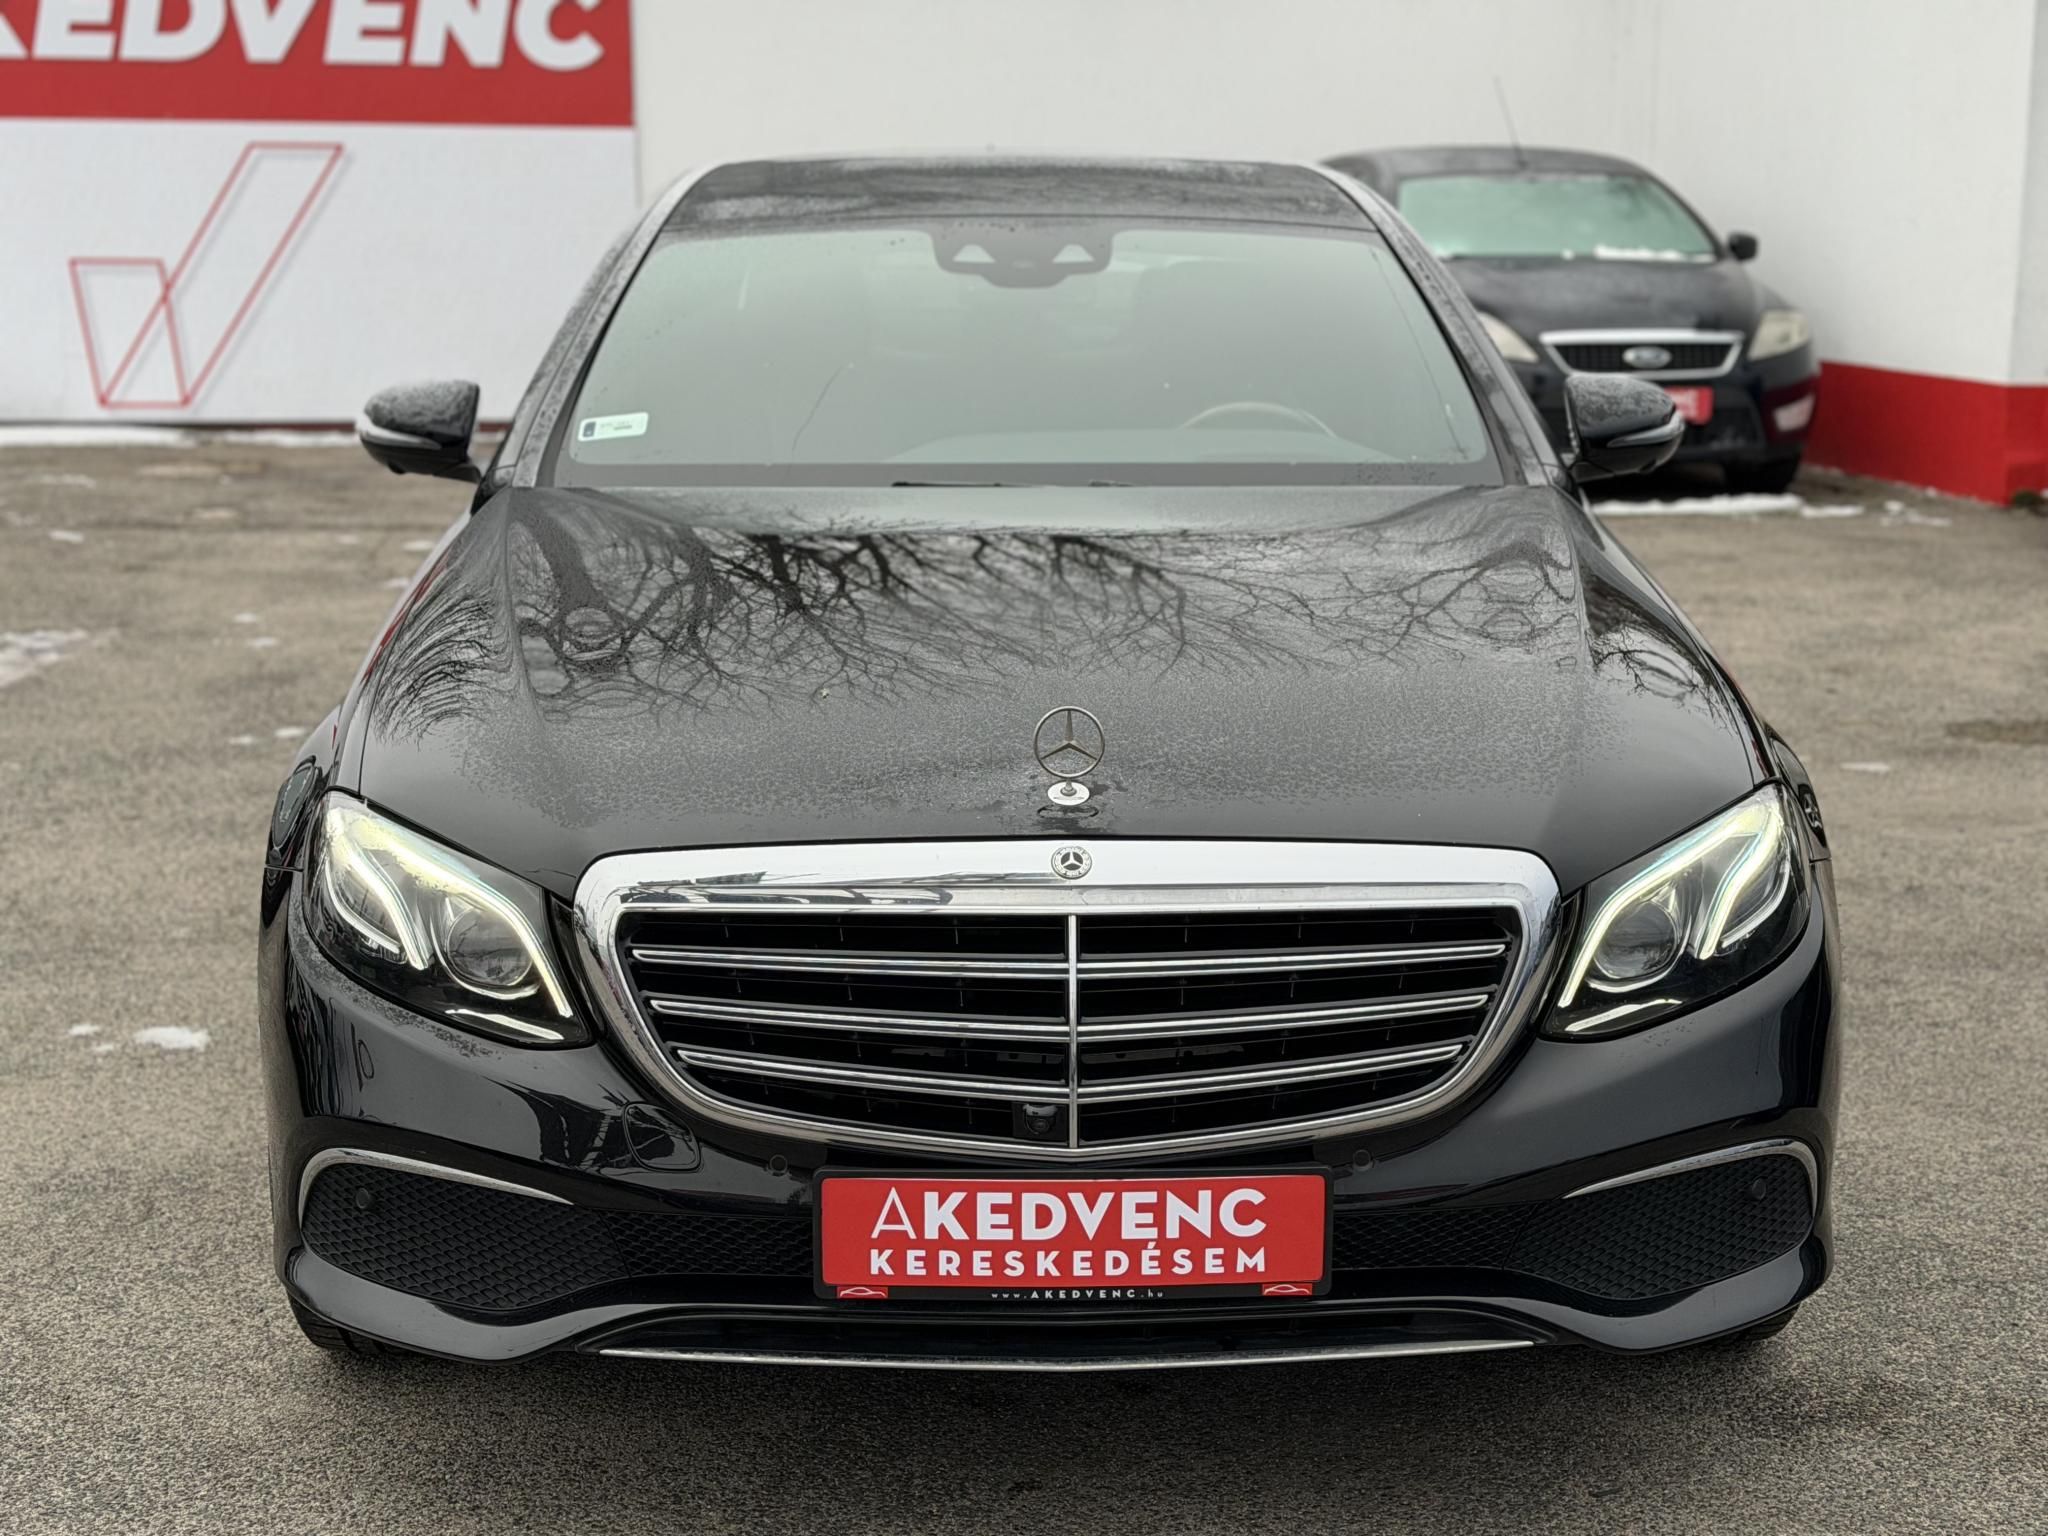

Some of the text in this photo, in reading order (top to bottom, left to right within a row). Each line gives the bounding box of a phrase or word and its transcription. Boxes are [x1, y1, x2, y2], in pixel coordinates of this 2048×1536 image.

[870, 1187, 1267, 1241] AKEDVENC
[870, 1241, 1266, 1277] KERESKEDÉSEM
[991, 1289, 1164, 1299] www.AKEDVENC.hu
